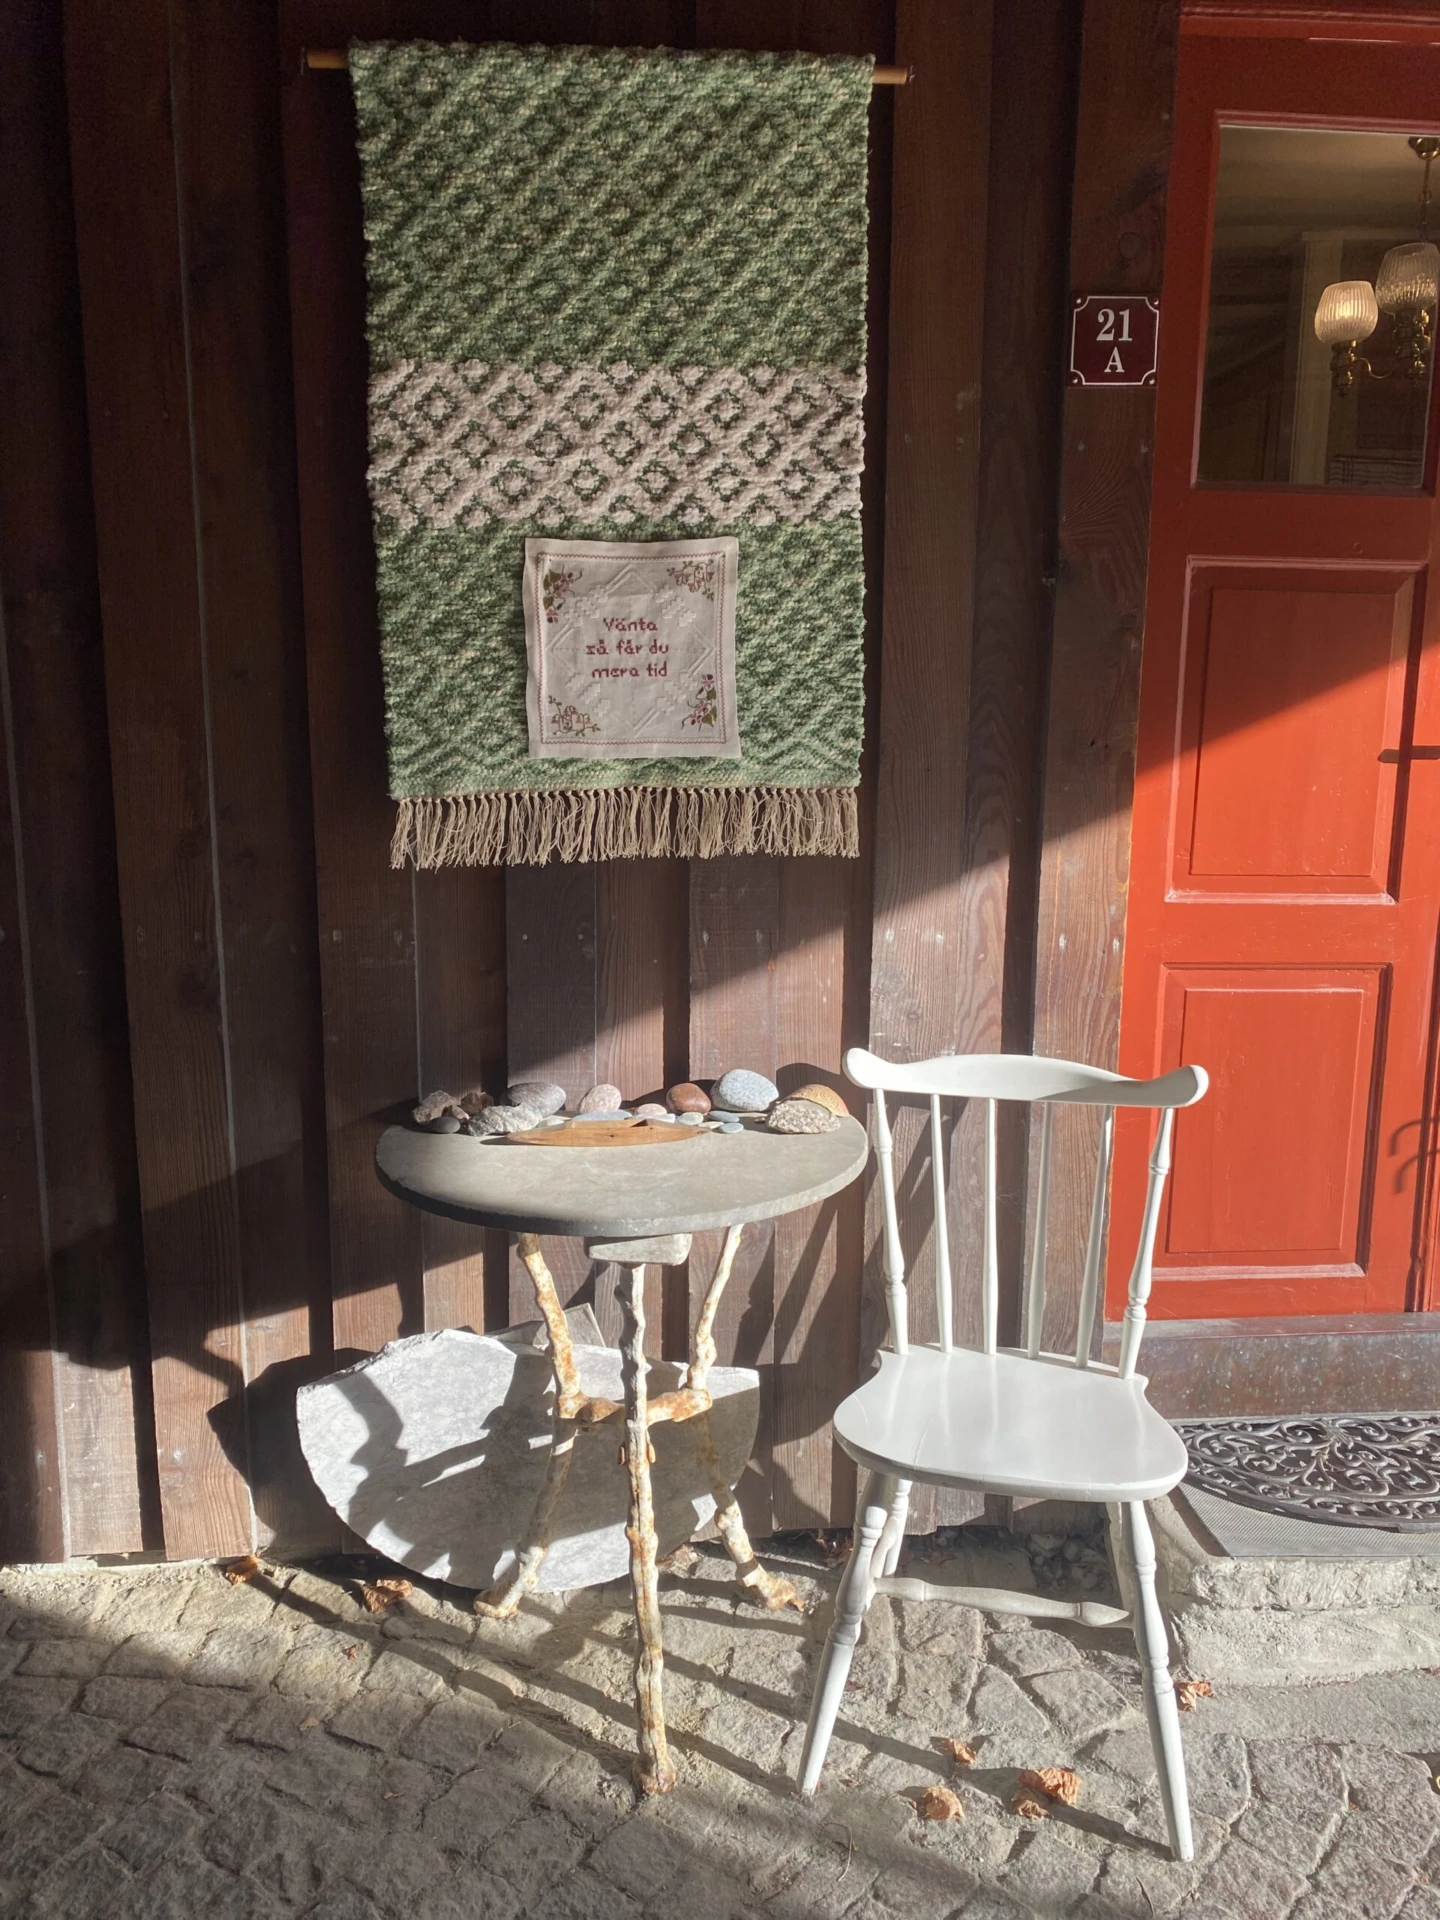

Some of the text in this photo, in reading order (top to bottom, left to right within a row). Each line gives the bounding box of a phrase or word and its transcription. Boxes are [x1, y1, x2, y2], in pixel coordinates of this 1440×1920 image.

[1096, 308, 1133, 341] 21
[1103, 346, 1125, 373] A
[603, 617, 658, 631] Vänta
[616, 639, 643, 655] får
[649, 638, 669, 655] du
[591, 661, 668, 678] mera tid
